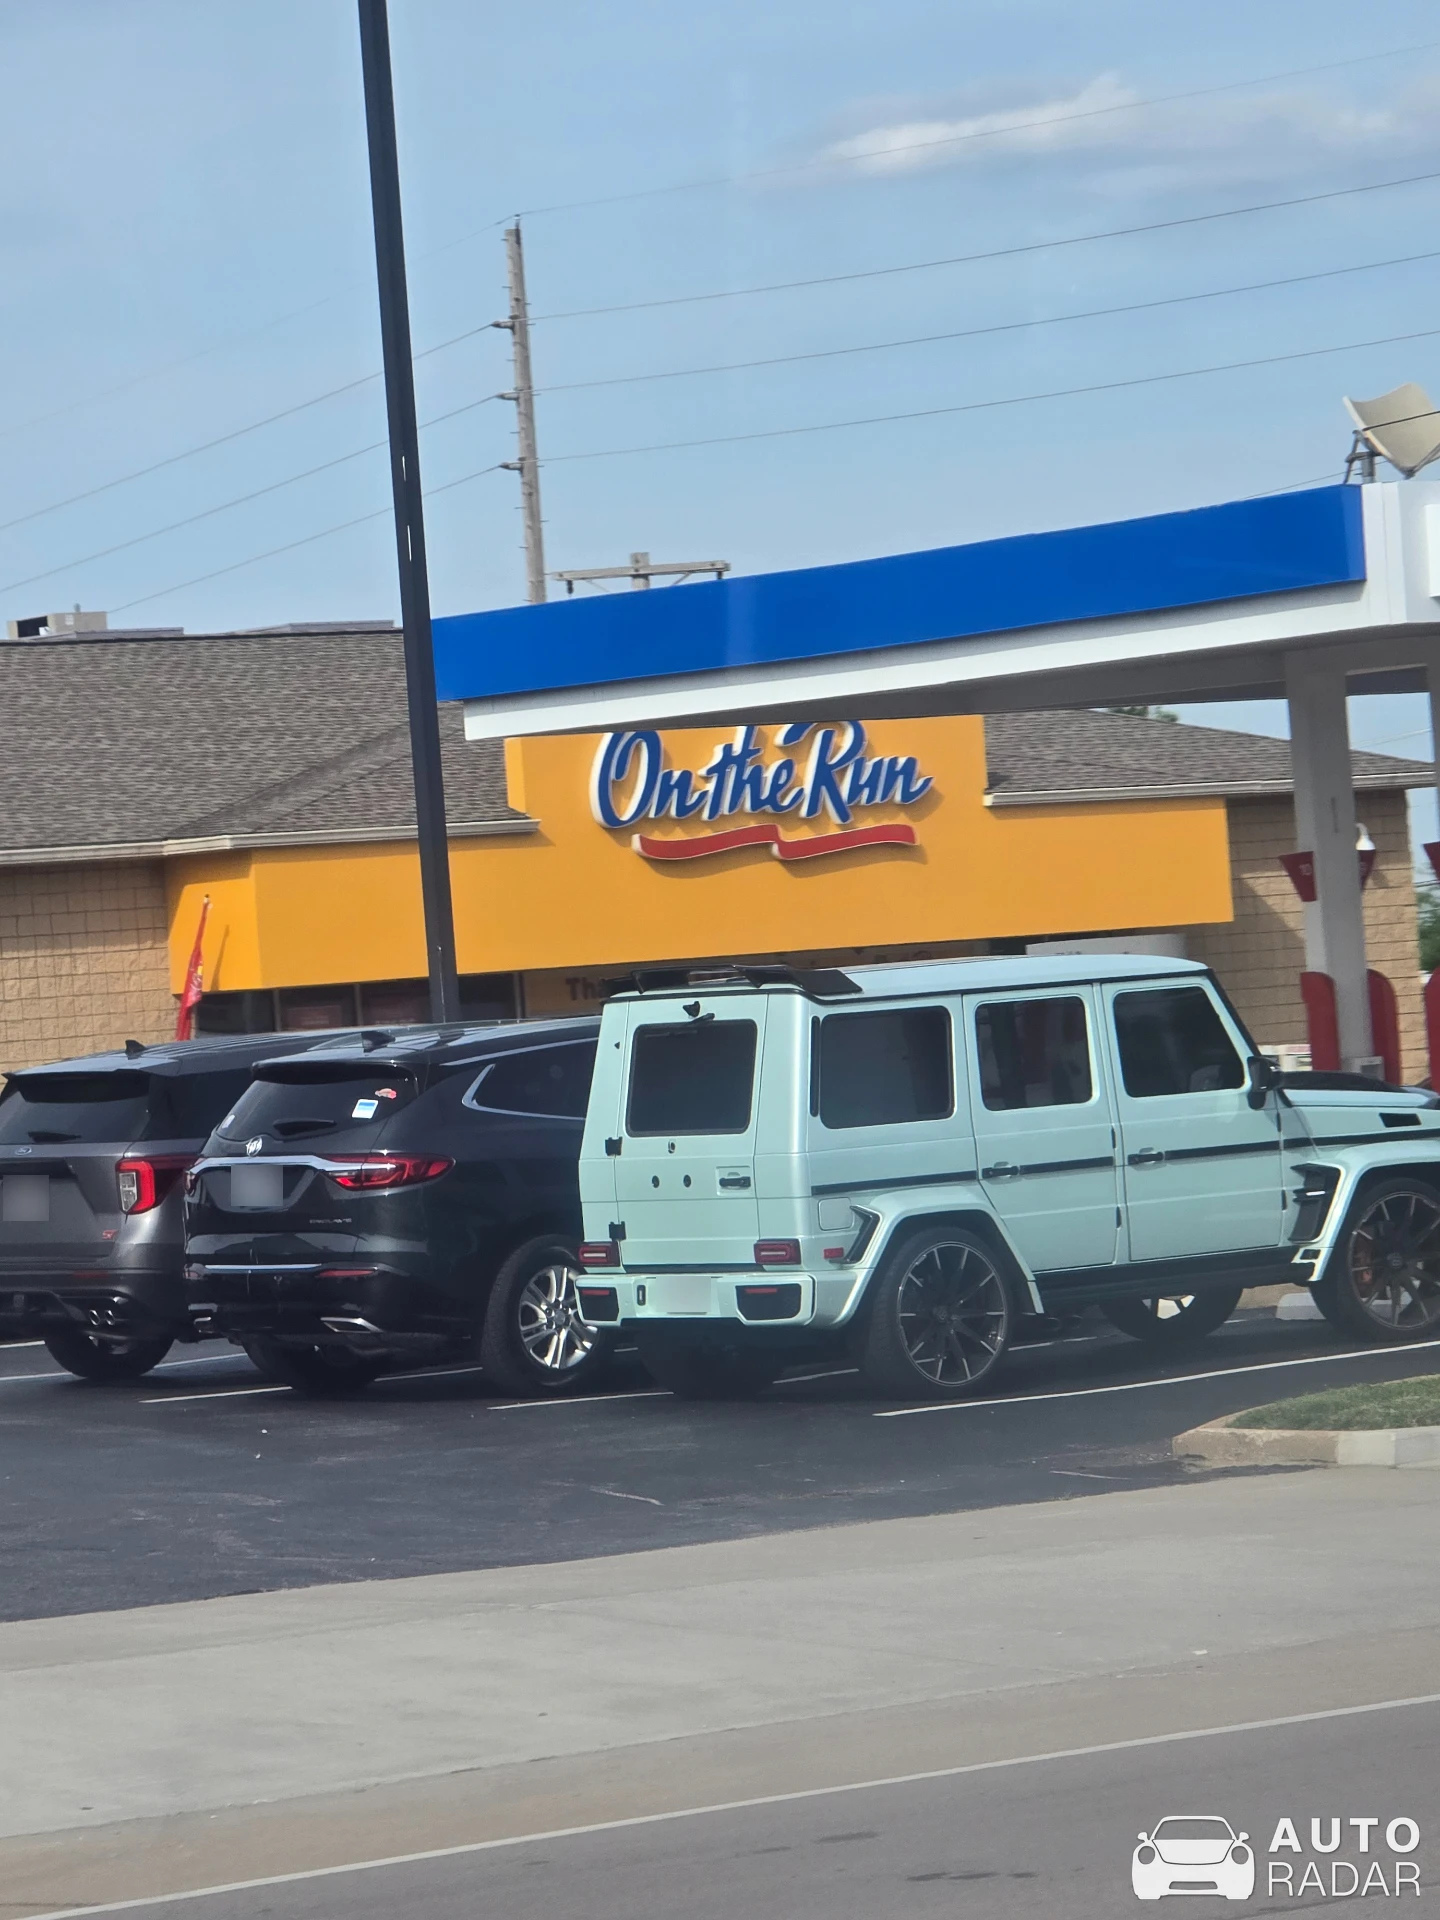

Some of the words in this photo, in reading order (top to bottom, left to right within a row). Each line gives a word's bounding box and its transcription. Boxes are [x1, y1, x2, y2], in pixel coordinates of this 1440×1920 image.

[590, 730, 709, 828] On
[698, 726, 804, 821] the
[775, 720, 934, 824] Run
